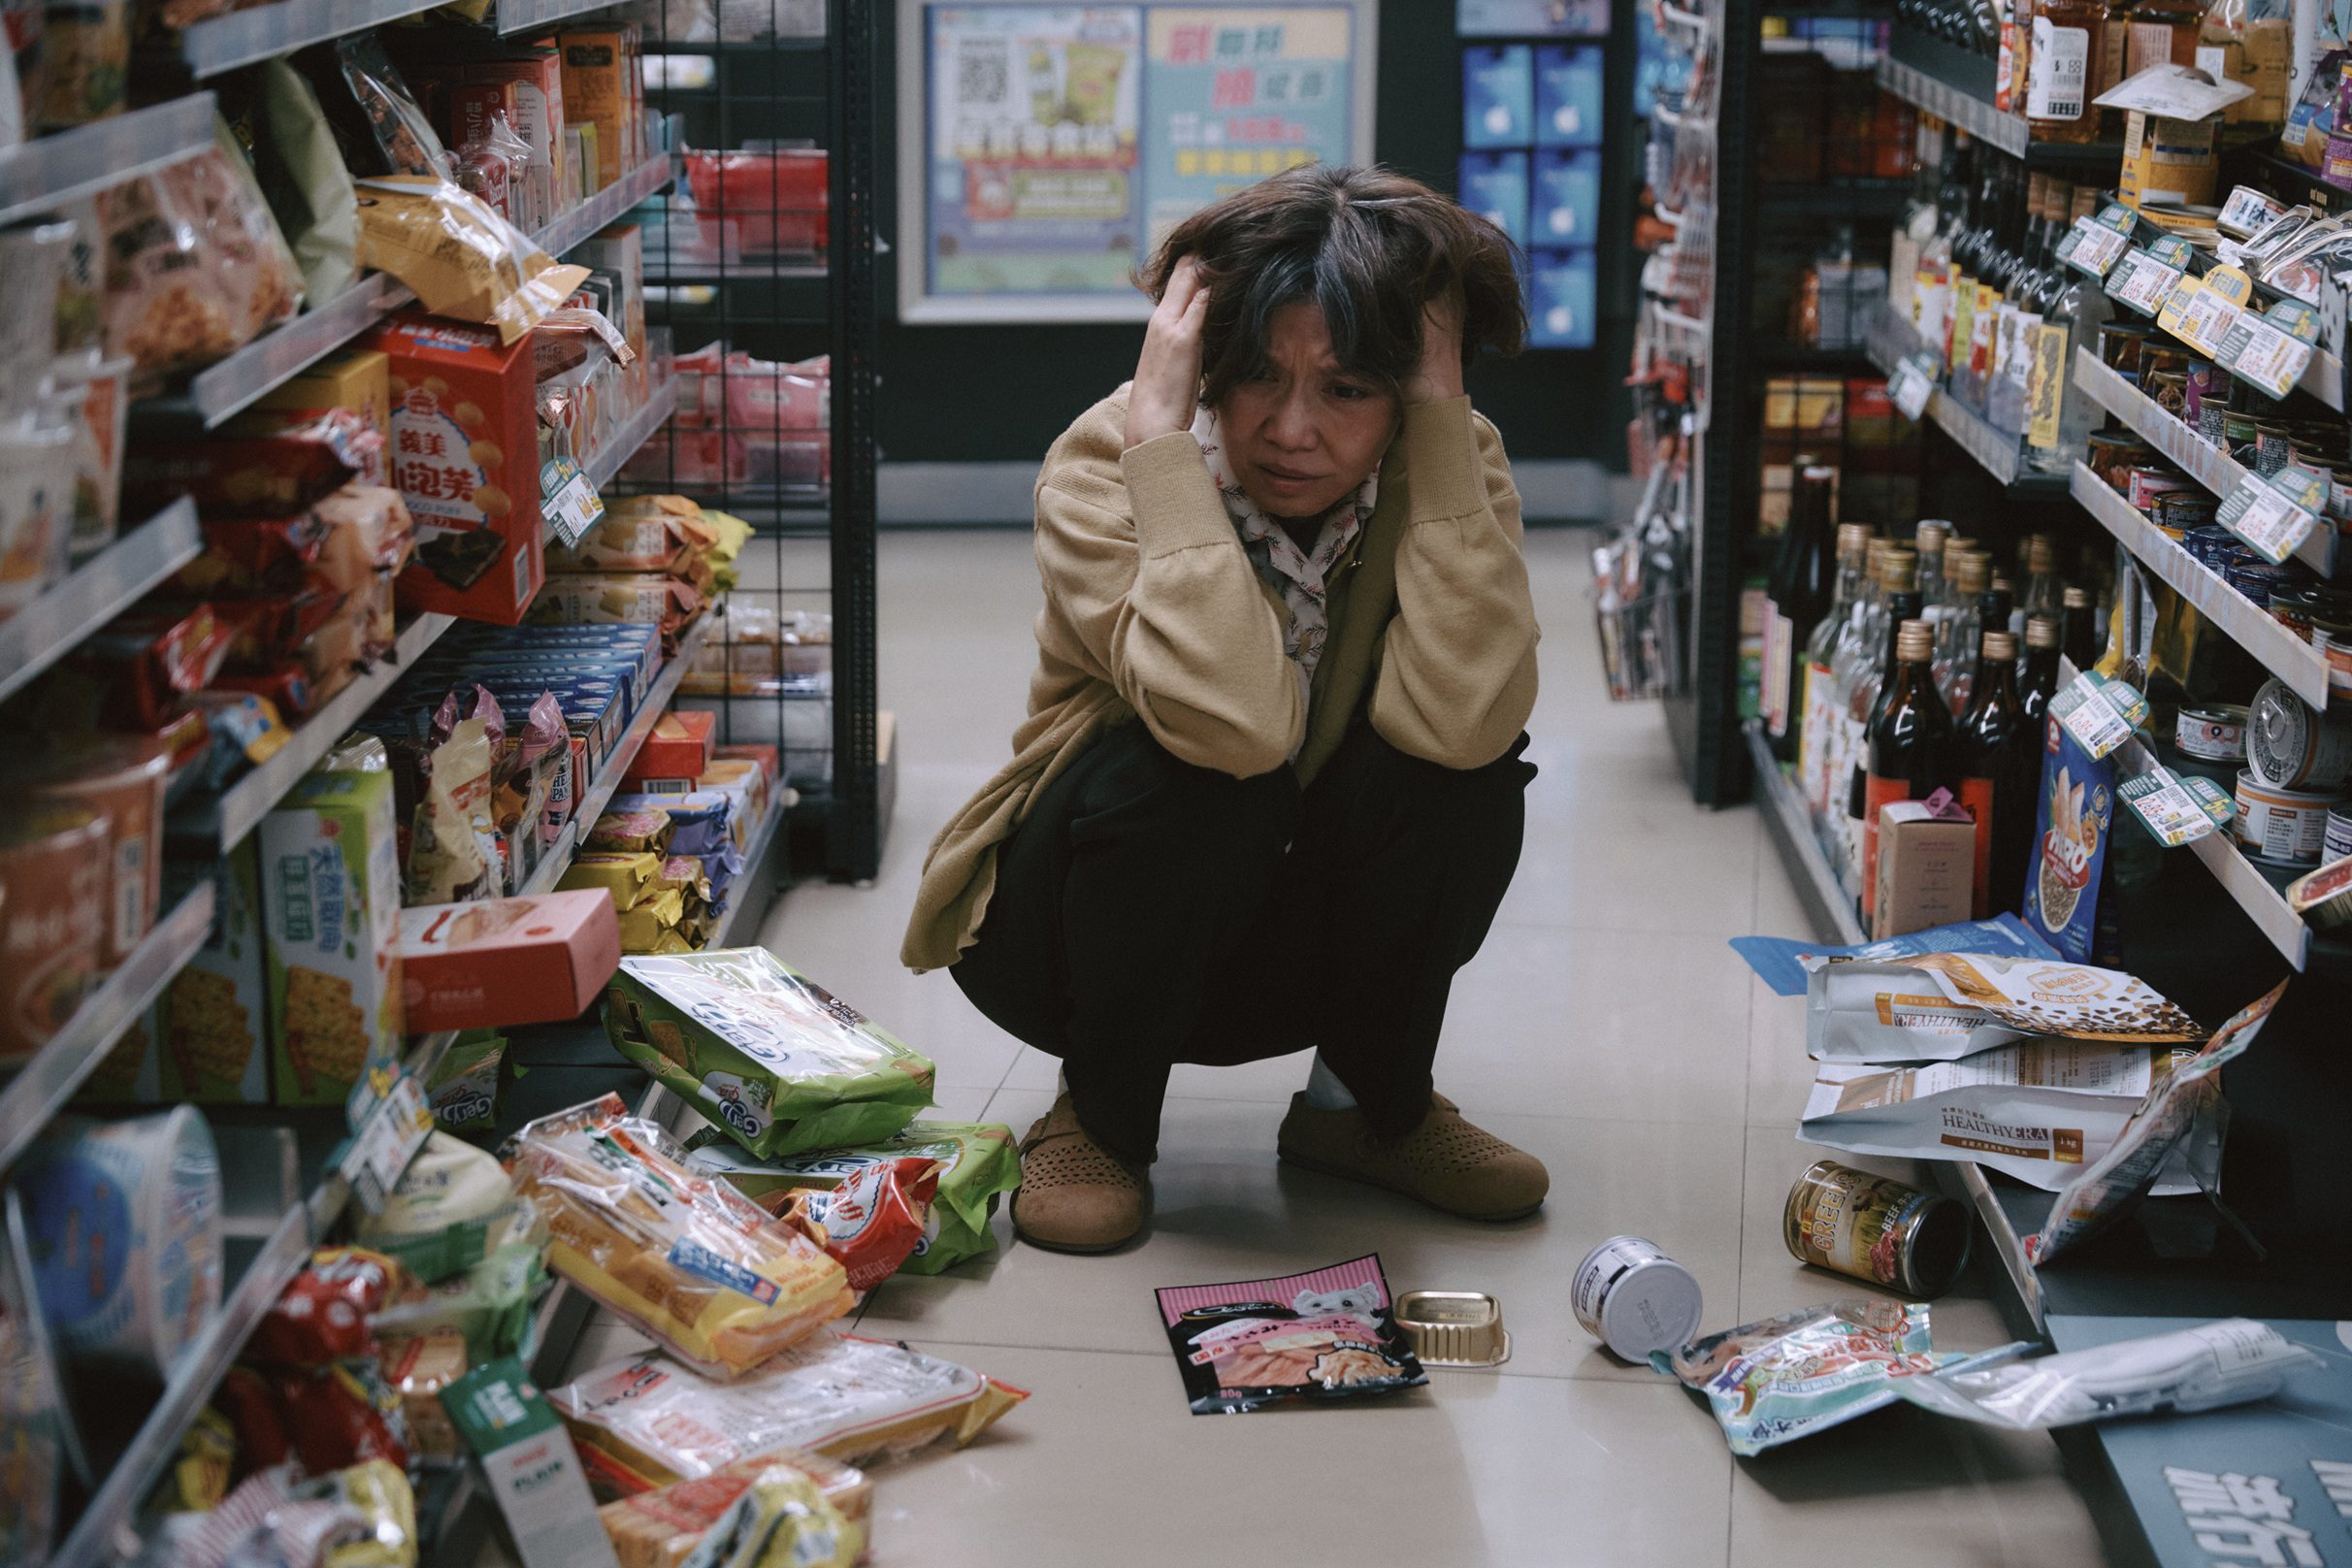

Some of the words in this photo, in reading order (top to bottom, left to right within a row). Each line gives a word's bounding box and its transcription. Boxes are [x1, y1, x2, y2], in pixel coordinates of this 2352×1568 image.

[441, 1091, 493, 1126] Gery
[718, 1097, 762, 1139] Gery
[1813, 1172, 1863, 1253] GREENS
[1881, 1202, 1901, 1232] BEEF
